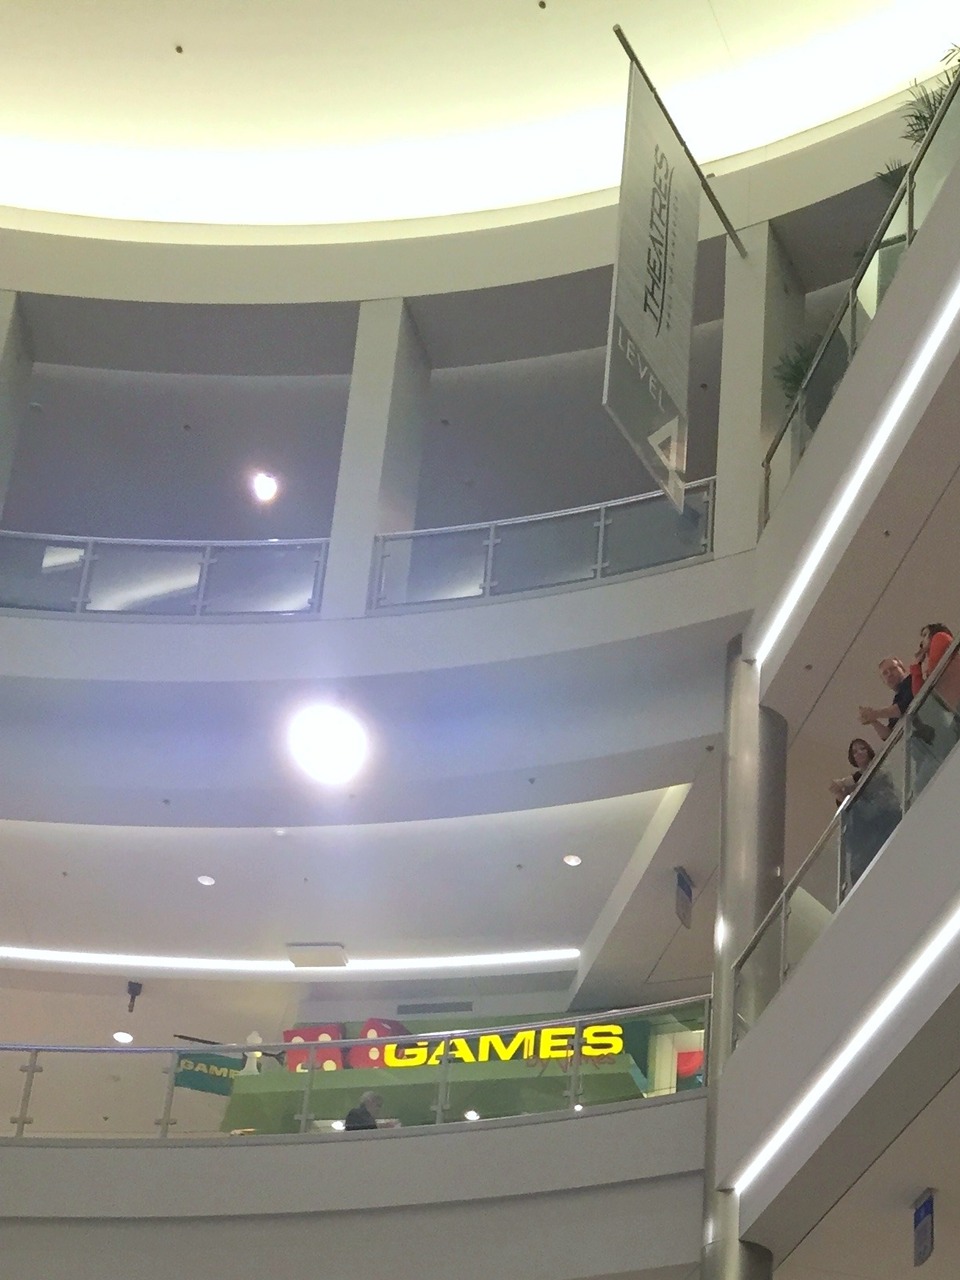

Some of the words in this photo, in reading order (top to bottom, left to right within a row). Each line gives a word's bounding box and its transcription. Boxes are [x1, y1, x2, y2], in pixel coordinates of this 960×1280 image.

[643, 143, 670, 323] THEATRES
[618, 326, 666, 413] LEVEL
[180, 1059, 242, 1079] GAME
[383, 1024, 624, 1068] GAMES
